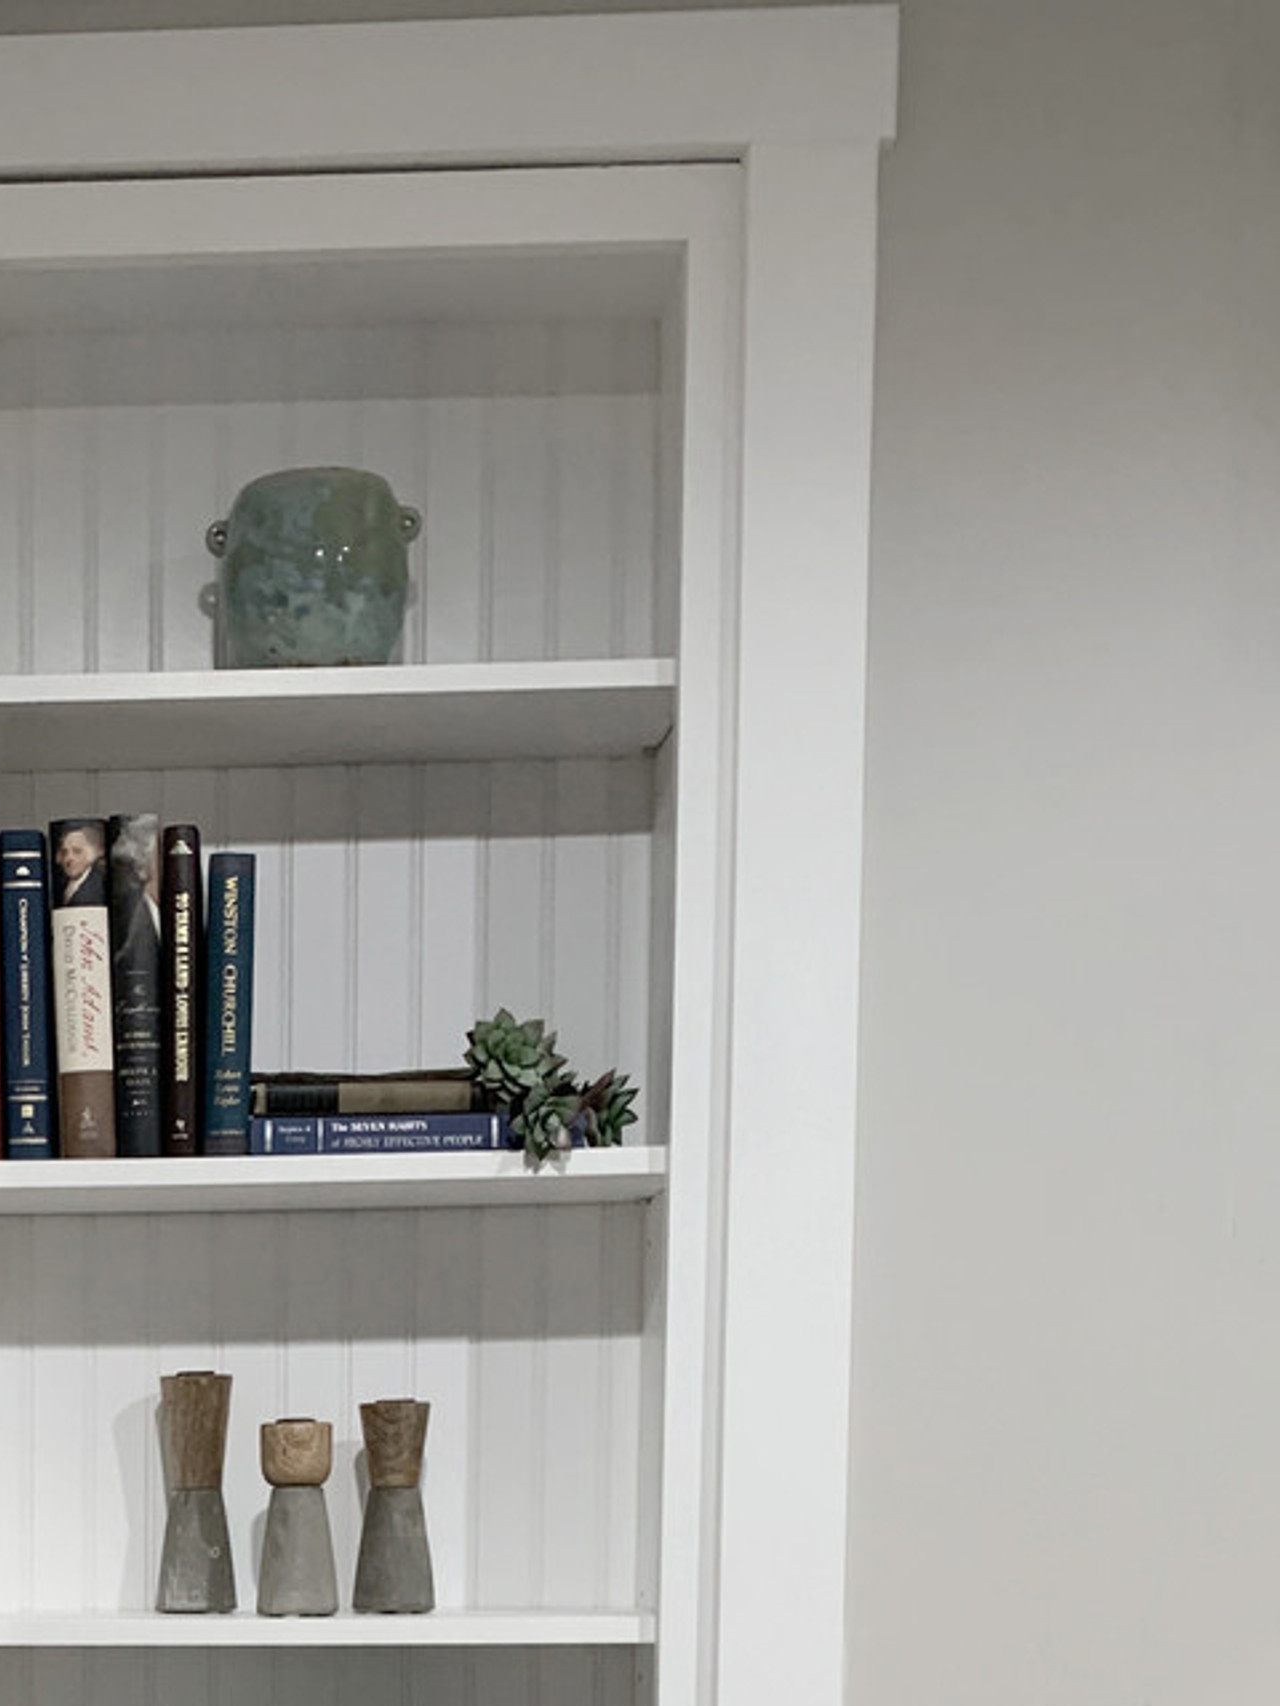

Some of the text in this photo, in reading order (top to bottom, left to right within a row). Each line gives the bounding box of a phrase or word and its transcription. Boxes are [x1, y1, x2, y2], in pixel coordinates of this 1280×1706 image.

[80, 920, 104, 970] John
[222, 877, 238, 1057] WINSTON CHURCHILL
[331, 1121, 428, 1132] The SEVEN HABITS
[383, 1134, 441, 1147] EFFECTIVE
[443, 1134, 484, 1146] PEOPLE
